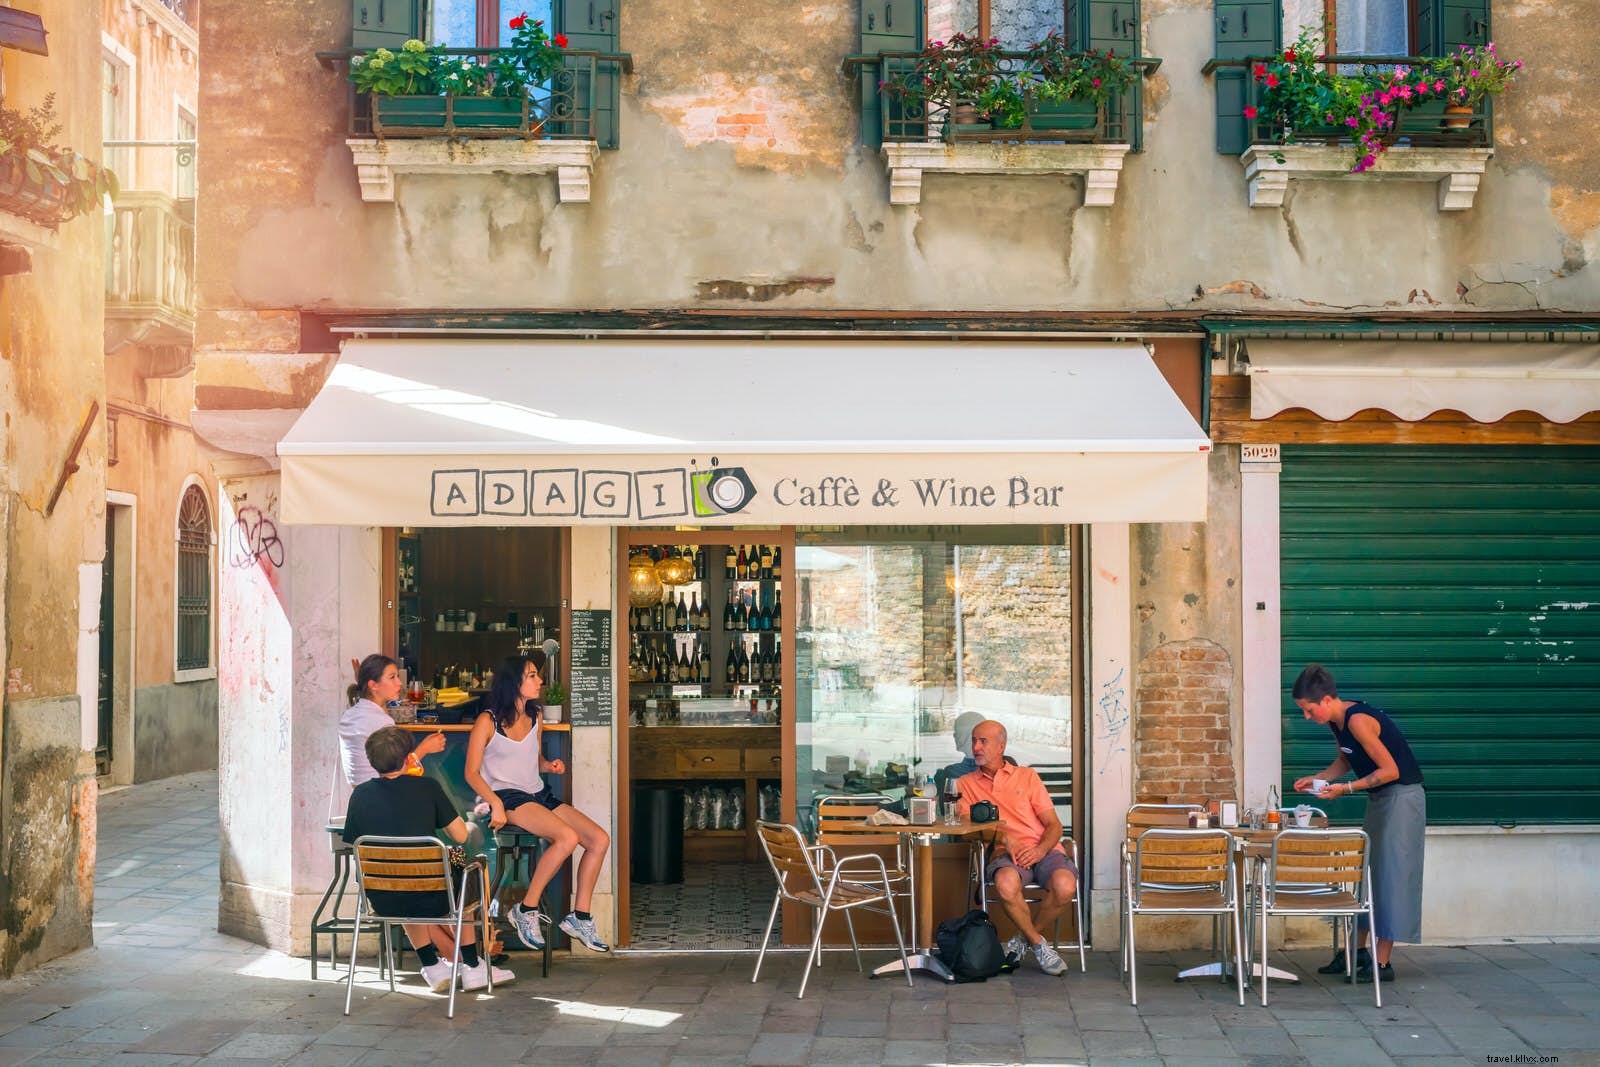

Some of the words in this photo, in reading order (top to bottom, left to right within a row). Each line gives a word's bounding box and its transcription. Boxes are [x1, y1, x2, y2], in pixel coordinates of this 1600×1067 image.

[1243, 447, 1277, 458] 5029
[773, 476, 861, 508] Caffè
[871, 478, 900, 507] &
[909, 476, 997, 508] Wine
[1007, 475, 1065, 509] Bar
